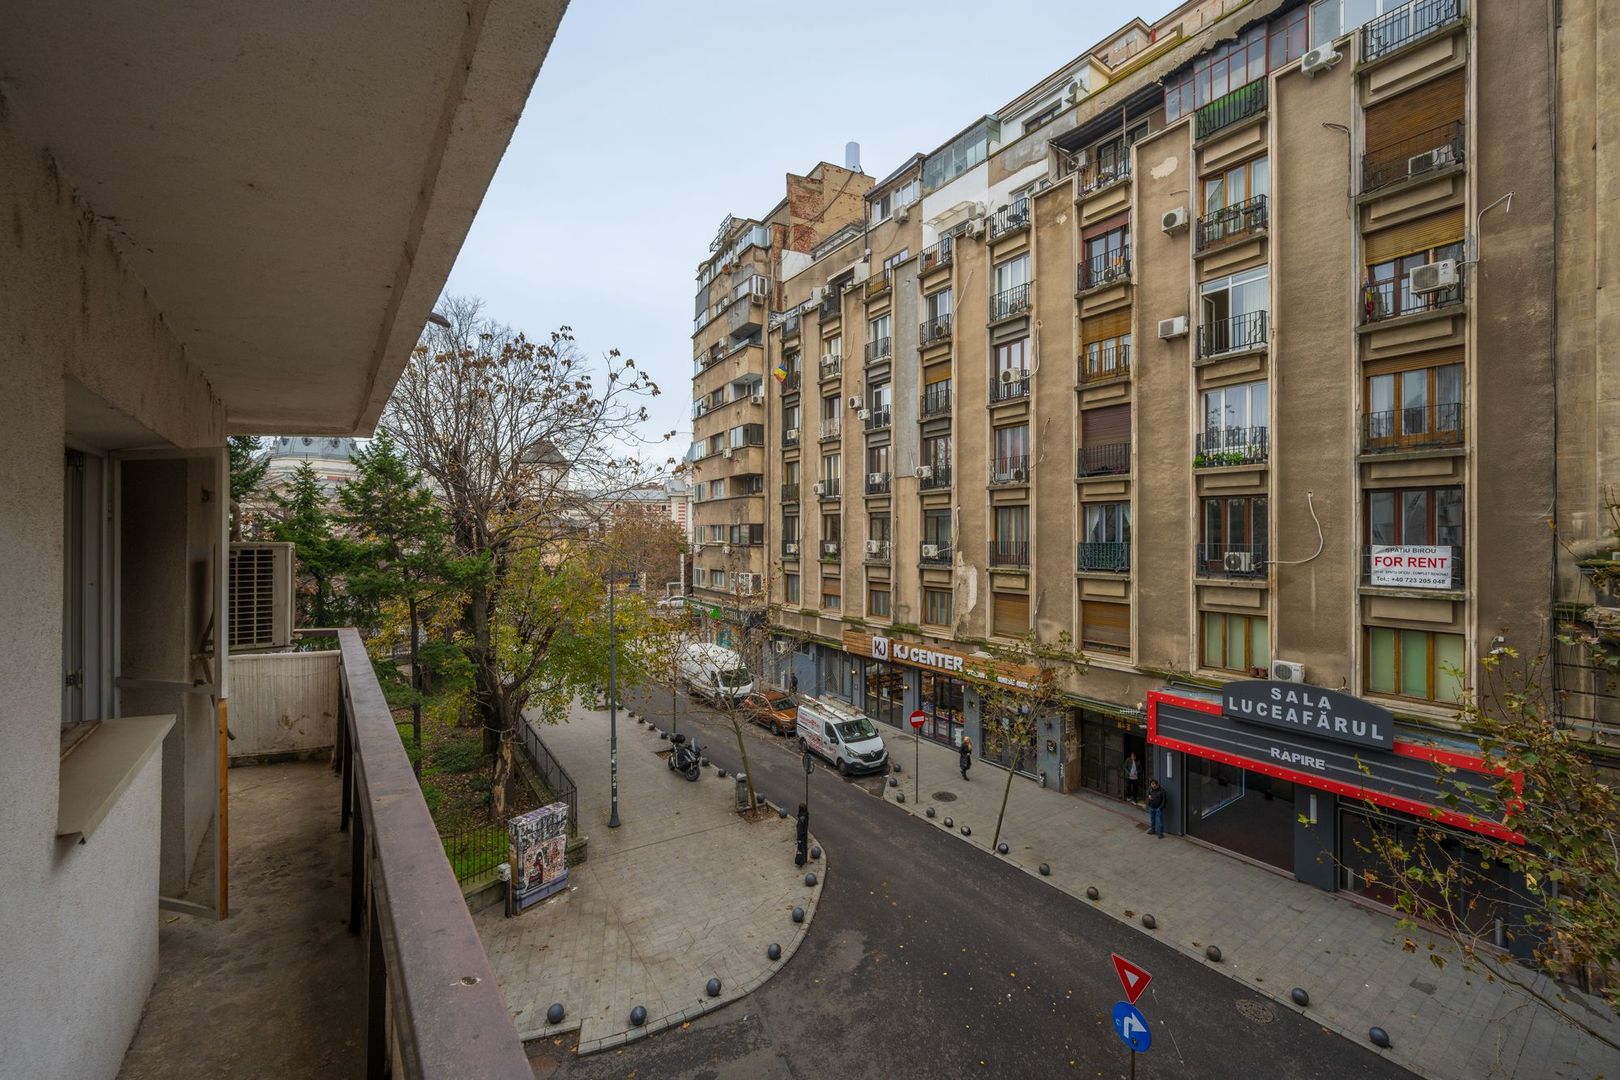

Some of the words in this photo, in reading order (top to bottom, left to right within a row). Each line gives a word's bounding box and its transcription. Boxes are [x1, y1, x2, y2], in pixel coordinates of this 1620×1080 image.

[1374, 556, 1403, 568] FOR
[1407, 557, 1448, 569] RENT
[874, 639, 887, 657] KJ
[893, 643, 910, 660] KJ
[910, 647, 964, 673] CENTER
[1270, 687, 1333, 710] SALA
[1228, 696, 1385, 741] LUCEAFĂRUL
